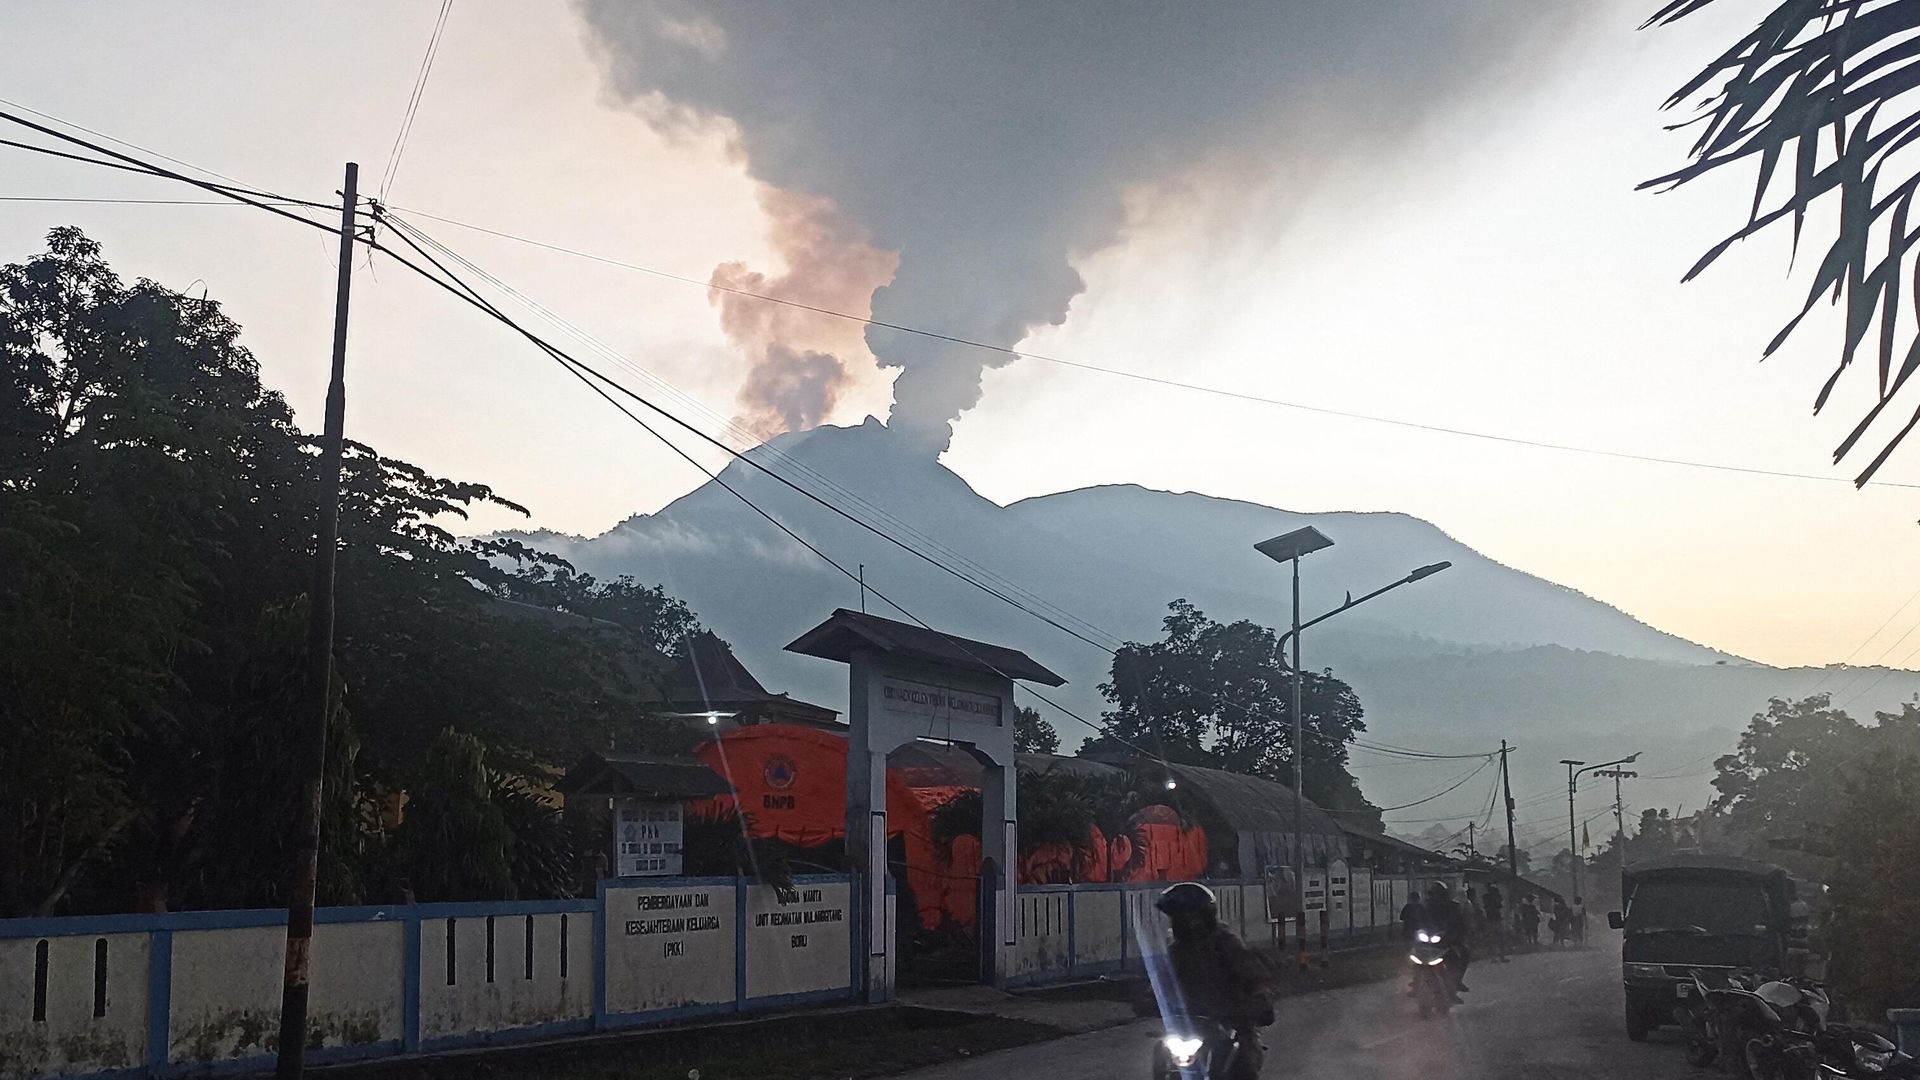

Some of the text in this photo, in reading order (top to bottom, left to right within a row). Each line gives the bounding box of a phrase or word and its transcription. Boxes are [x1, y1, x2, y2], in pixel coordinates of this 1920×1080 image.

[763, 795, 796, 810] BNPB
[638, 893, 709, 911] PEMBERDAYAAN DAN
[626, 916, 720, 936] KESEJAHTERAAN KELUARGA
[664, 941, 684, 959] (PKK)
